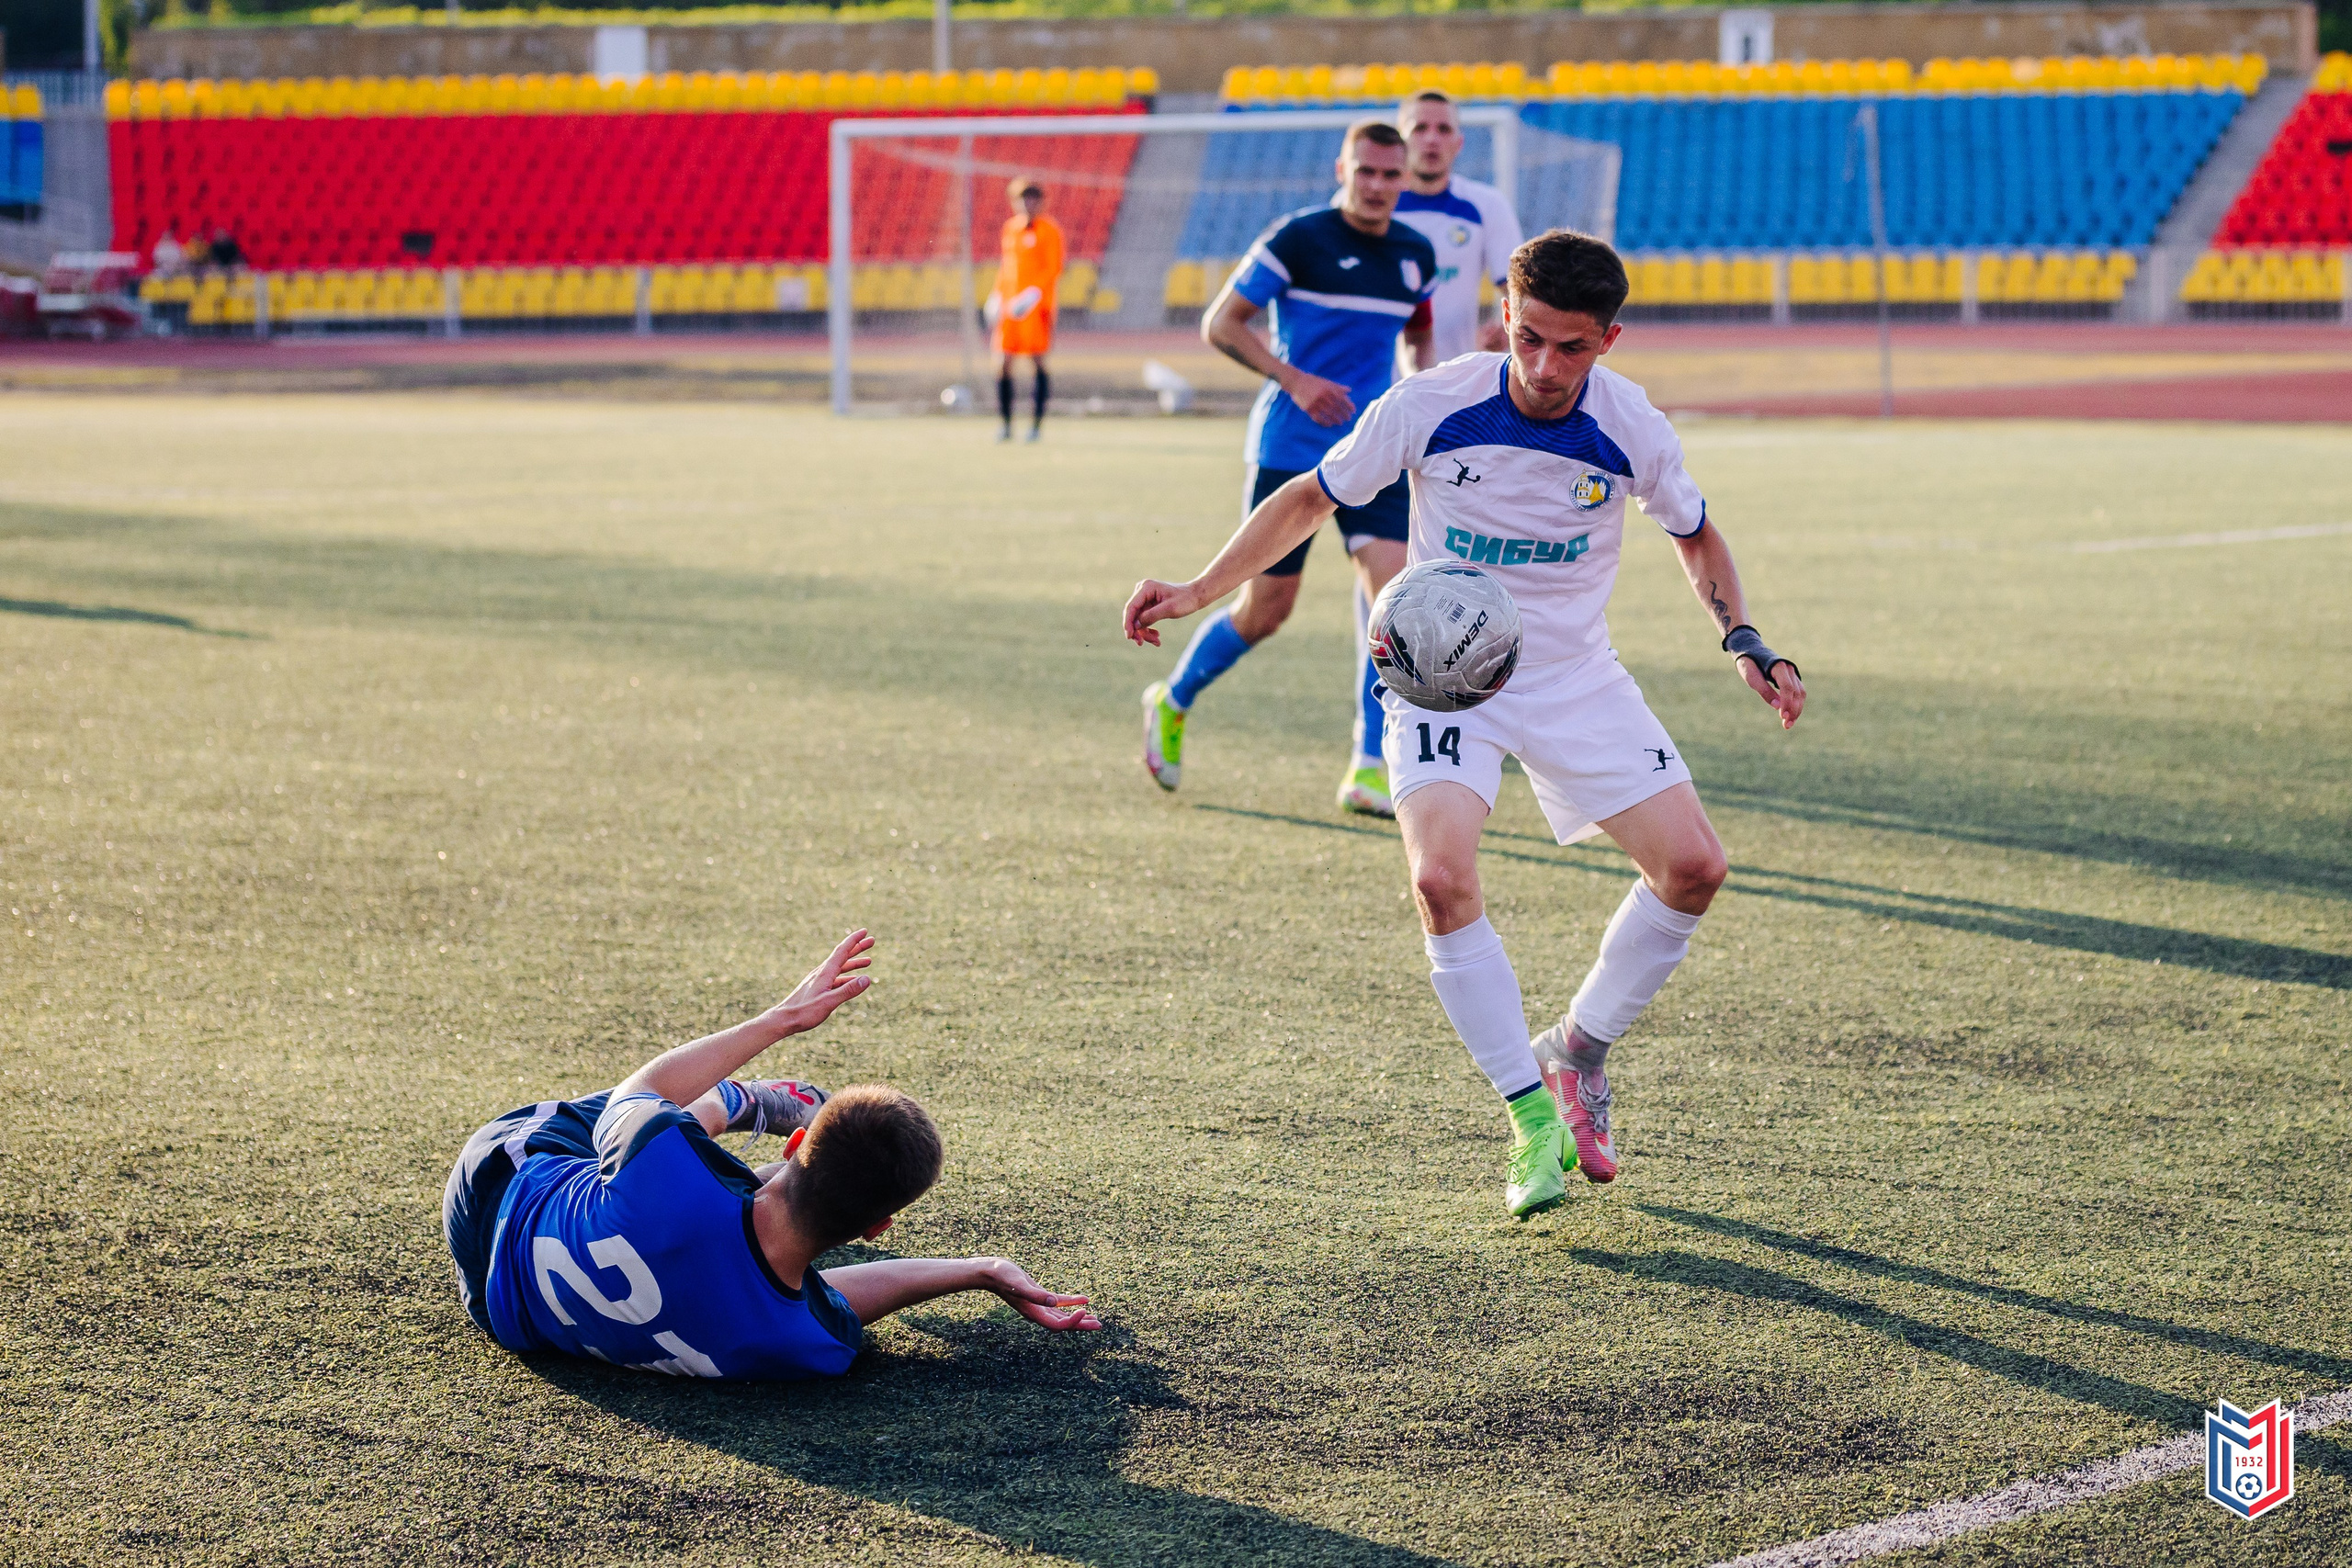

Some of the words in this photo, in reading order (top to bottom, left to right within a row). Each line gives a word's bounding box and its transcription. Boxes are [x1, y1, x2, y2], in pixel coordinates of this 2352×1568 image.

[1445, 525, 1589, 565] СИБУР
[1443, 610, 1488, 671] DEMIX
[1416, 723, 1461, 766] 14
